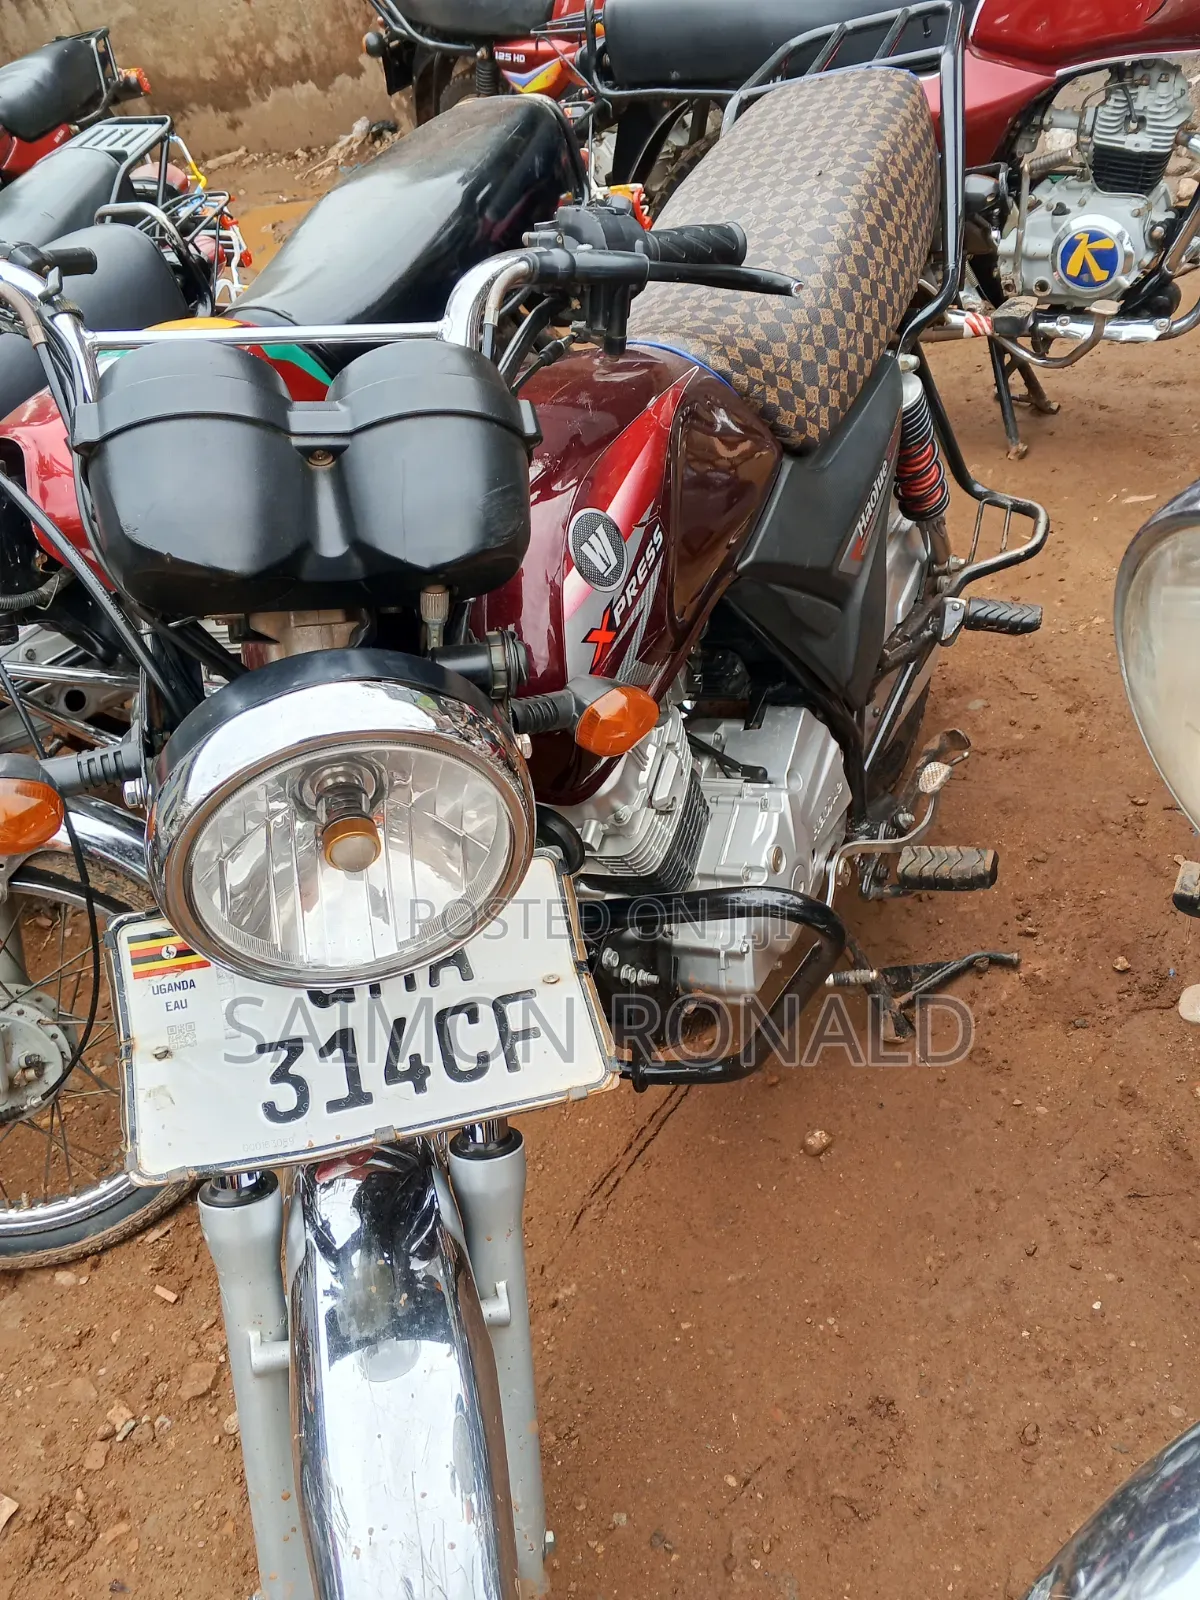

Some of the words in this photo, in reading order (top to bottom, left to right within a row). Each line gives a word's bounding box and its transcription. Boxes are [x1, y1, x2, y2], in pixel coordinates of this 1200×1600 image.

[495, 51, 512, 61] 125
[513, 53, 526, 63] HD
[1066, 232, 1115, 282] K
[152, 979, 196, 996] UGANDA
[165, 998, 188, 1012] EAU
[255, 988, 542, 1124] 314CF
